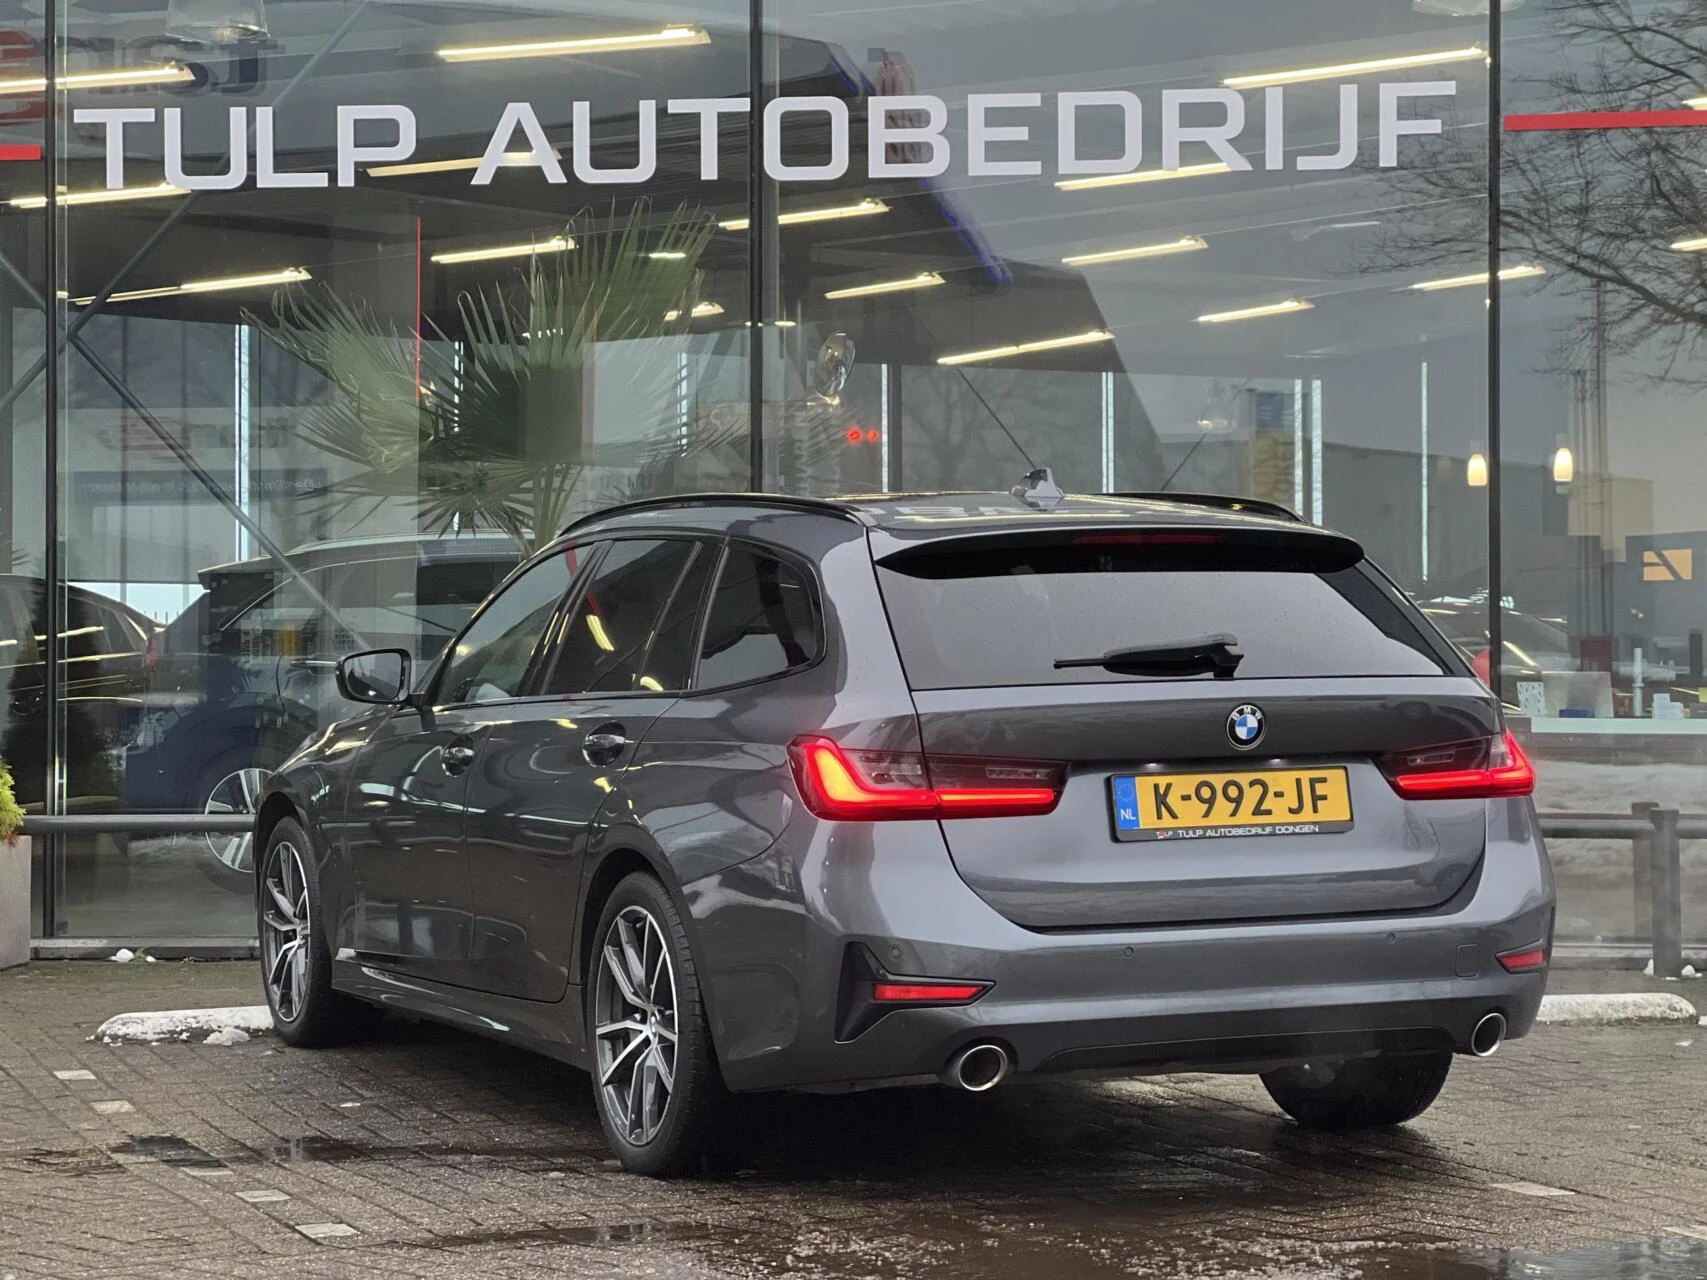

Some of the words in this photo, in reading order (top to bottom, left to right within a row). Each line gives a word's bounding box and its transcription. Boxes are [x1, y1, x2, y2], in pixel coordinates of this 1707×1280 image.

[72, 104, 417, 190] TULP
[471, 80, 1458, 185] AUTOBEDRIJF
[1231, 705, 1262, 720] BMW
[1153, 776, 1329, 820] K-992-JF
[1120, 808, 1137, 821] NL
[1178, 829, 1203, 838] TULP
[1206, 826, 1273, 837] AUTOBEDRIJF
[1276, 824, 1319, 834] DONGEN
